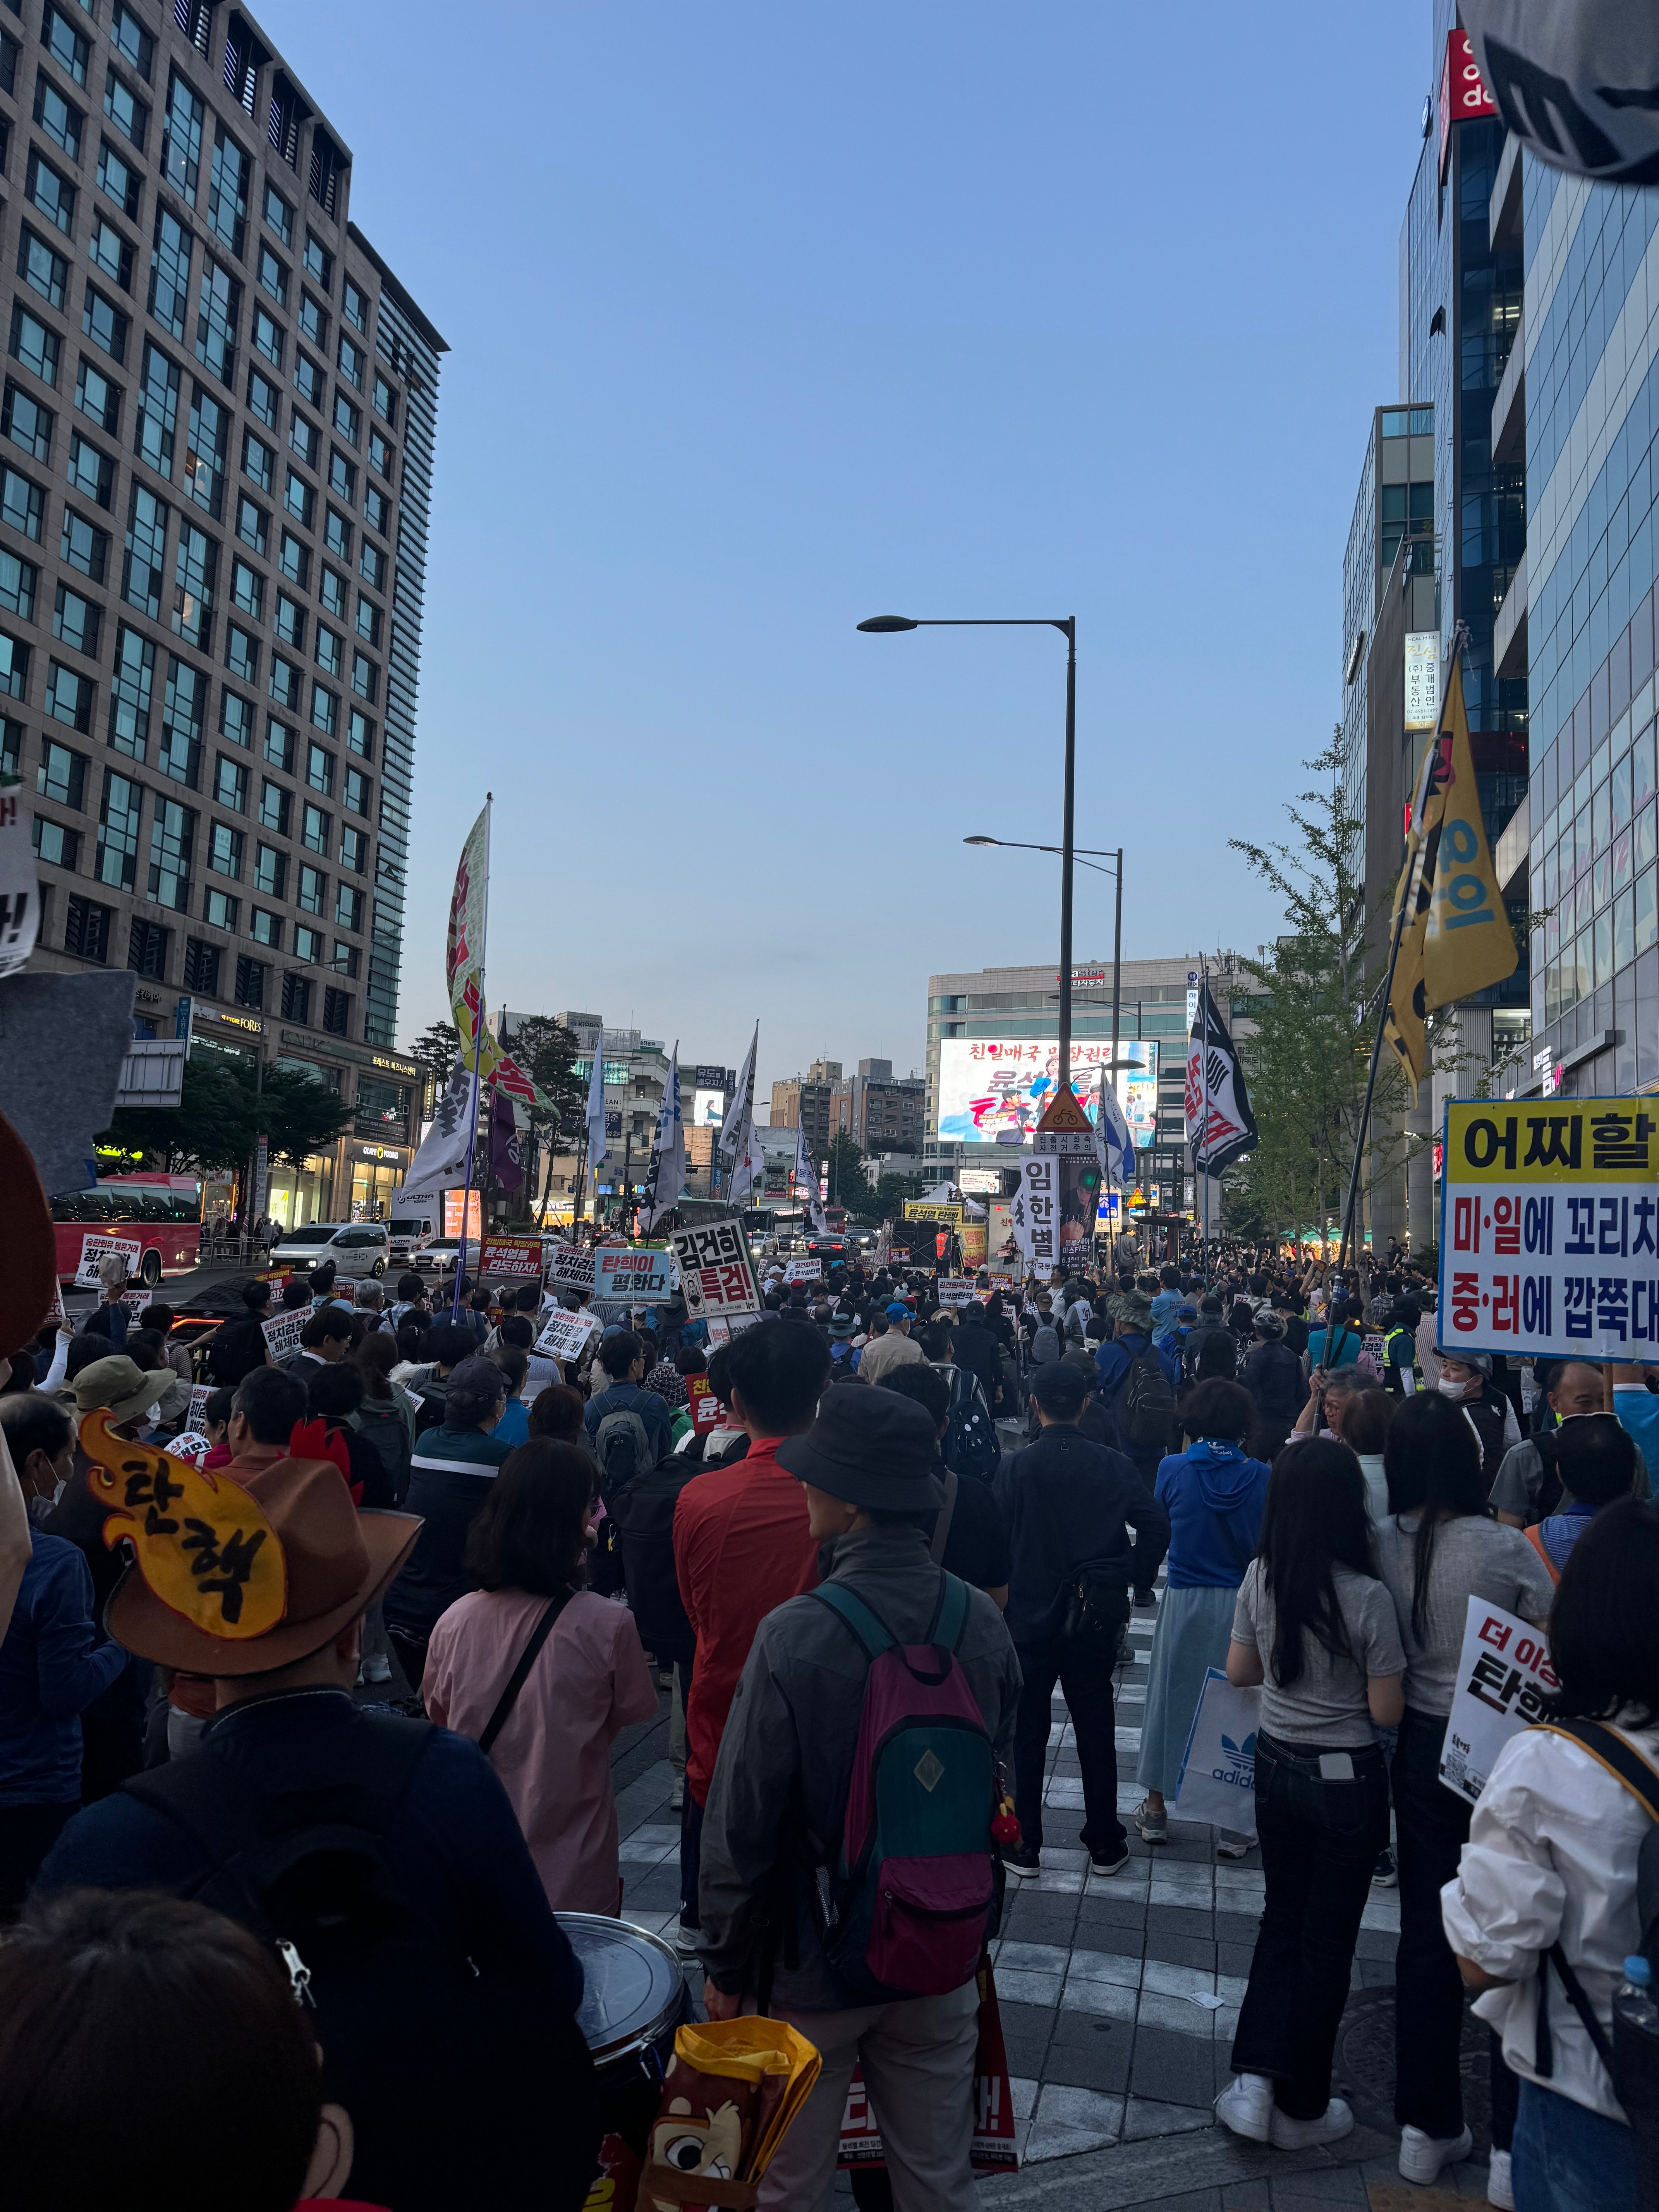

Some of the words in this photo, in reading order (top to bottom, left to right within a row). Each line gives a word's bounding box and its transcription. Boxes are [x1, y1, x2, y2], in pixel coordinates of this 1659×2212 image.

[1407, 644, 1437, 659] 진심
[1411, 675, 1420, 707] 부동산
[1425, 663, 1435, 706] 중개법인
[240, 1018, 263, 1032] FORES
[969, 1042, 1041, 1062] 친일매국
[372, 1056, 390, 1068] 포레스트
[391, 1061, 416, 1077] 비즈니스센터
[363, 1146, 377, 1156] OLIVE
[383, 1150, 398, 1159] YOUNG
[1464, 1113, 1656, 1170] 어찌할
[908, 1209, 936, 1219] 윤석열
[1025, 1162, 1054, 1258] 임한별
[1455, 1196, 1554, 1255] 미·일에
[484, 1246, 530, 1261] 윤석열을
[675, 1225, 744, 1272] 김건희
[489, 1259, 538, 1273] 타도하자!
[601, 1255, 654, 1273] 탄핵이
[611, 1274, 665, 1292] 평화다
[699, 1262, 754, 1304] 특검!
[1452, 1272, 1552, 1336] 중·러에
[267, 1318, 307, 1343] 정치검찰
[547, 1320, 583, 1338] 정치검찰
[122, 1457, 267, 1624] 탄핵
[1478, 1616, 1513, 1651] 더
[1212, 1768, 1255, 1790] adid
